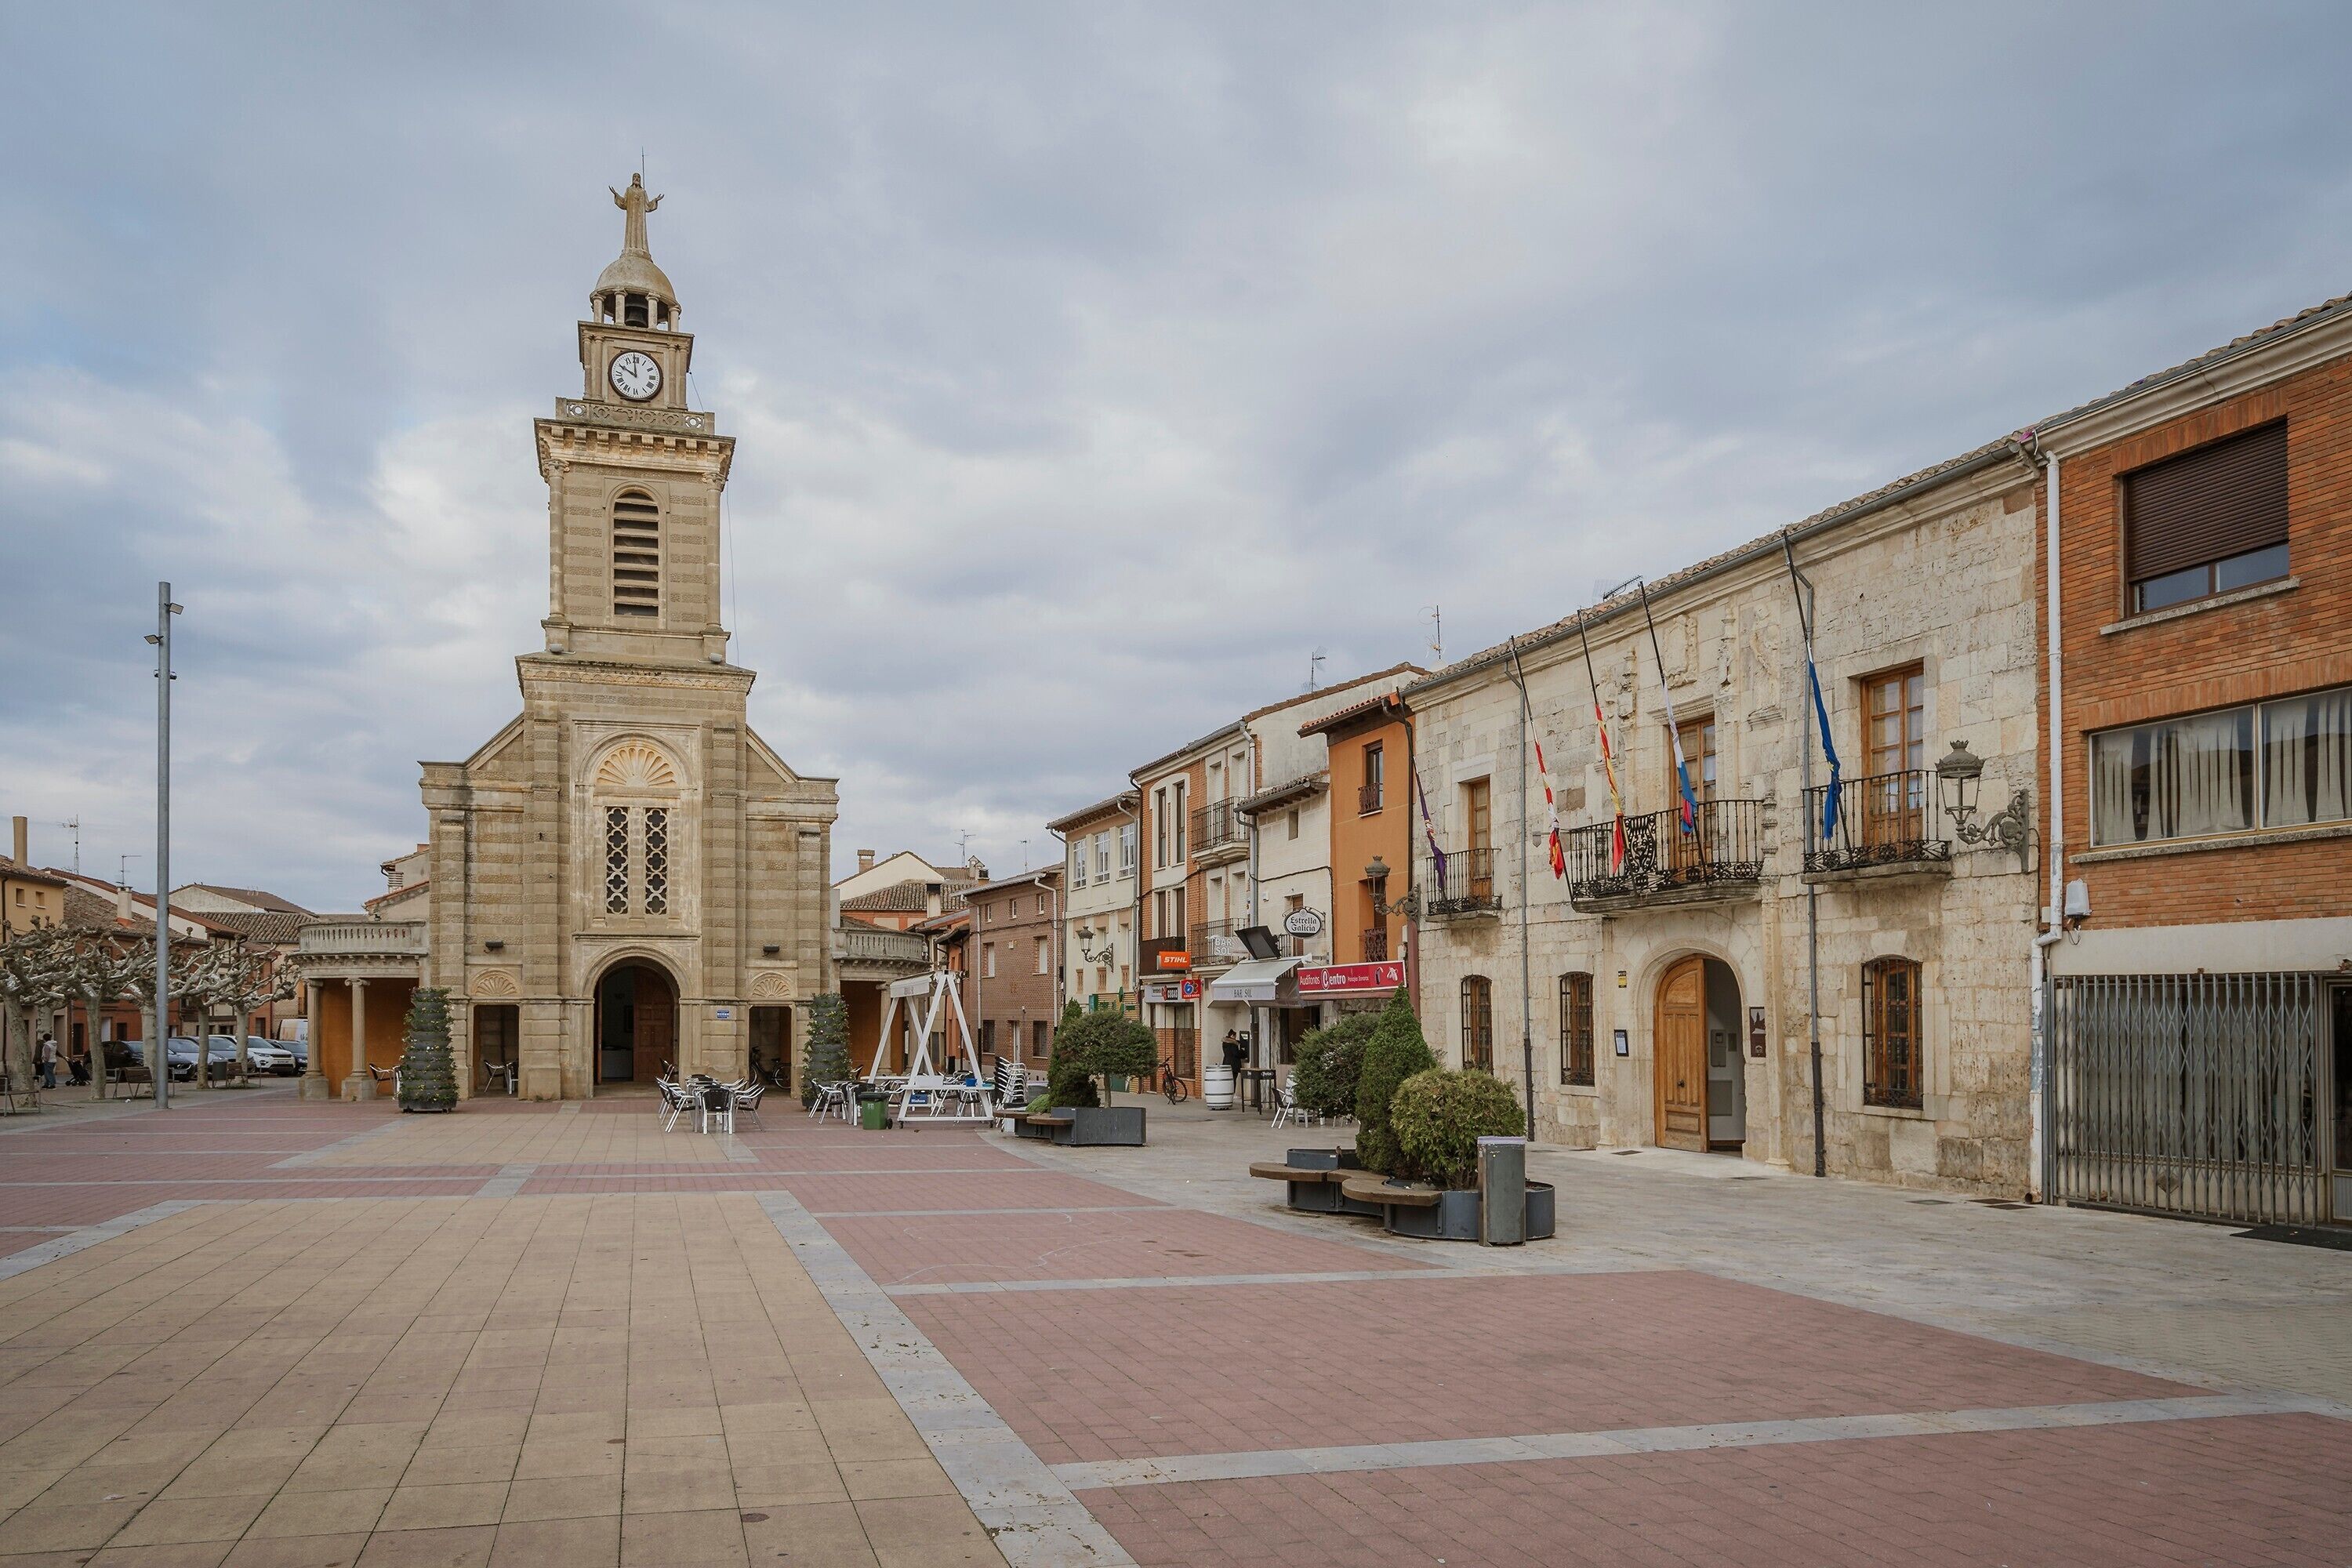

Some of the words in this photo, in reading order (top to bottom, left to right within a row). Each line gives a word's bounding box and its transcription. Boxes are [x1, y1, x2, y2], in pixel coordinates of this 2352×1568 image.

[1216, 938, 1232, 946] BAR
[1216, 946, 1232, 955] SOL
[1299, 974, 1320, 985] Audífonos
[1322, 970, 1346, 989] Centro
